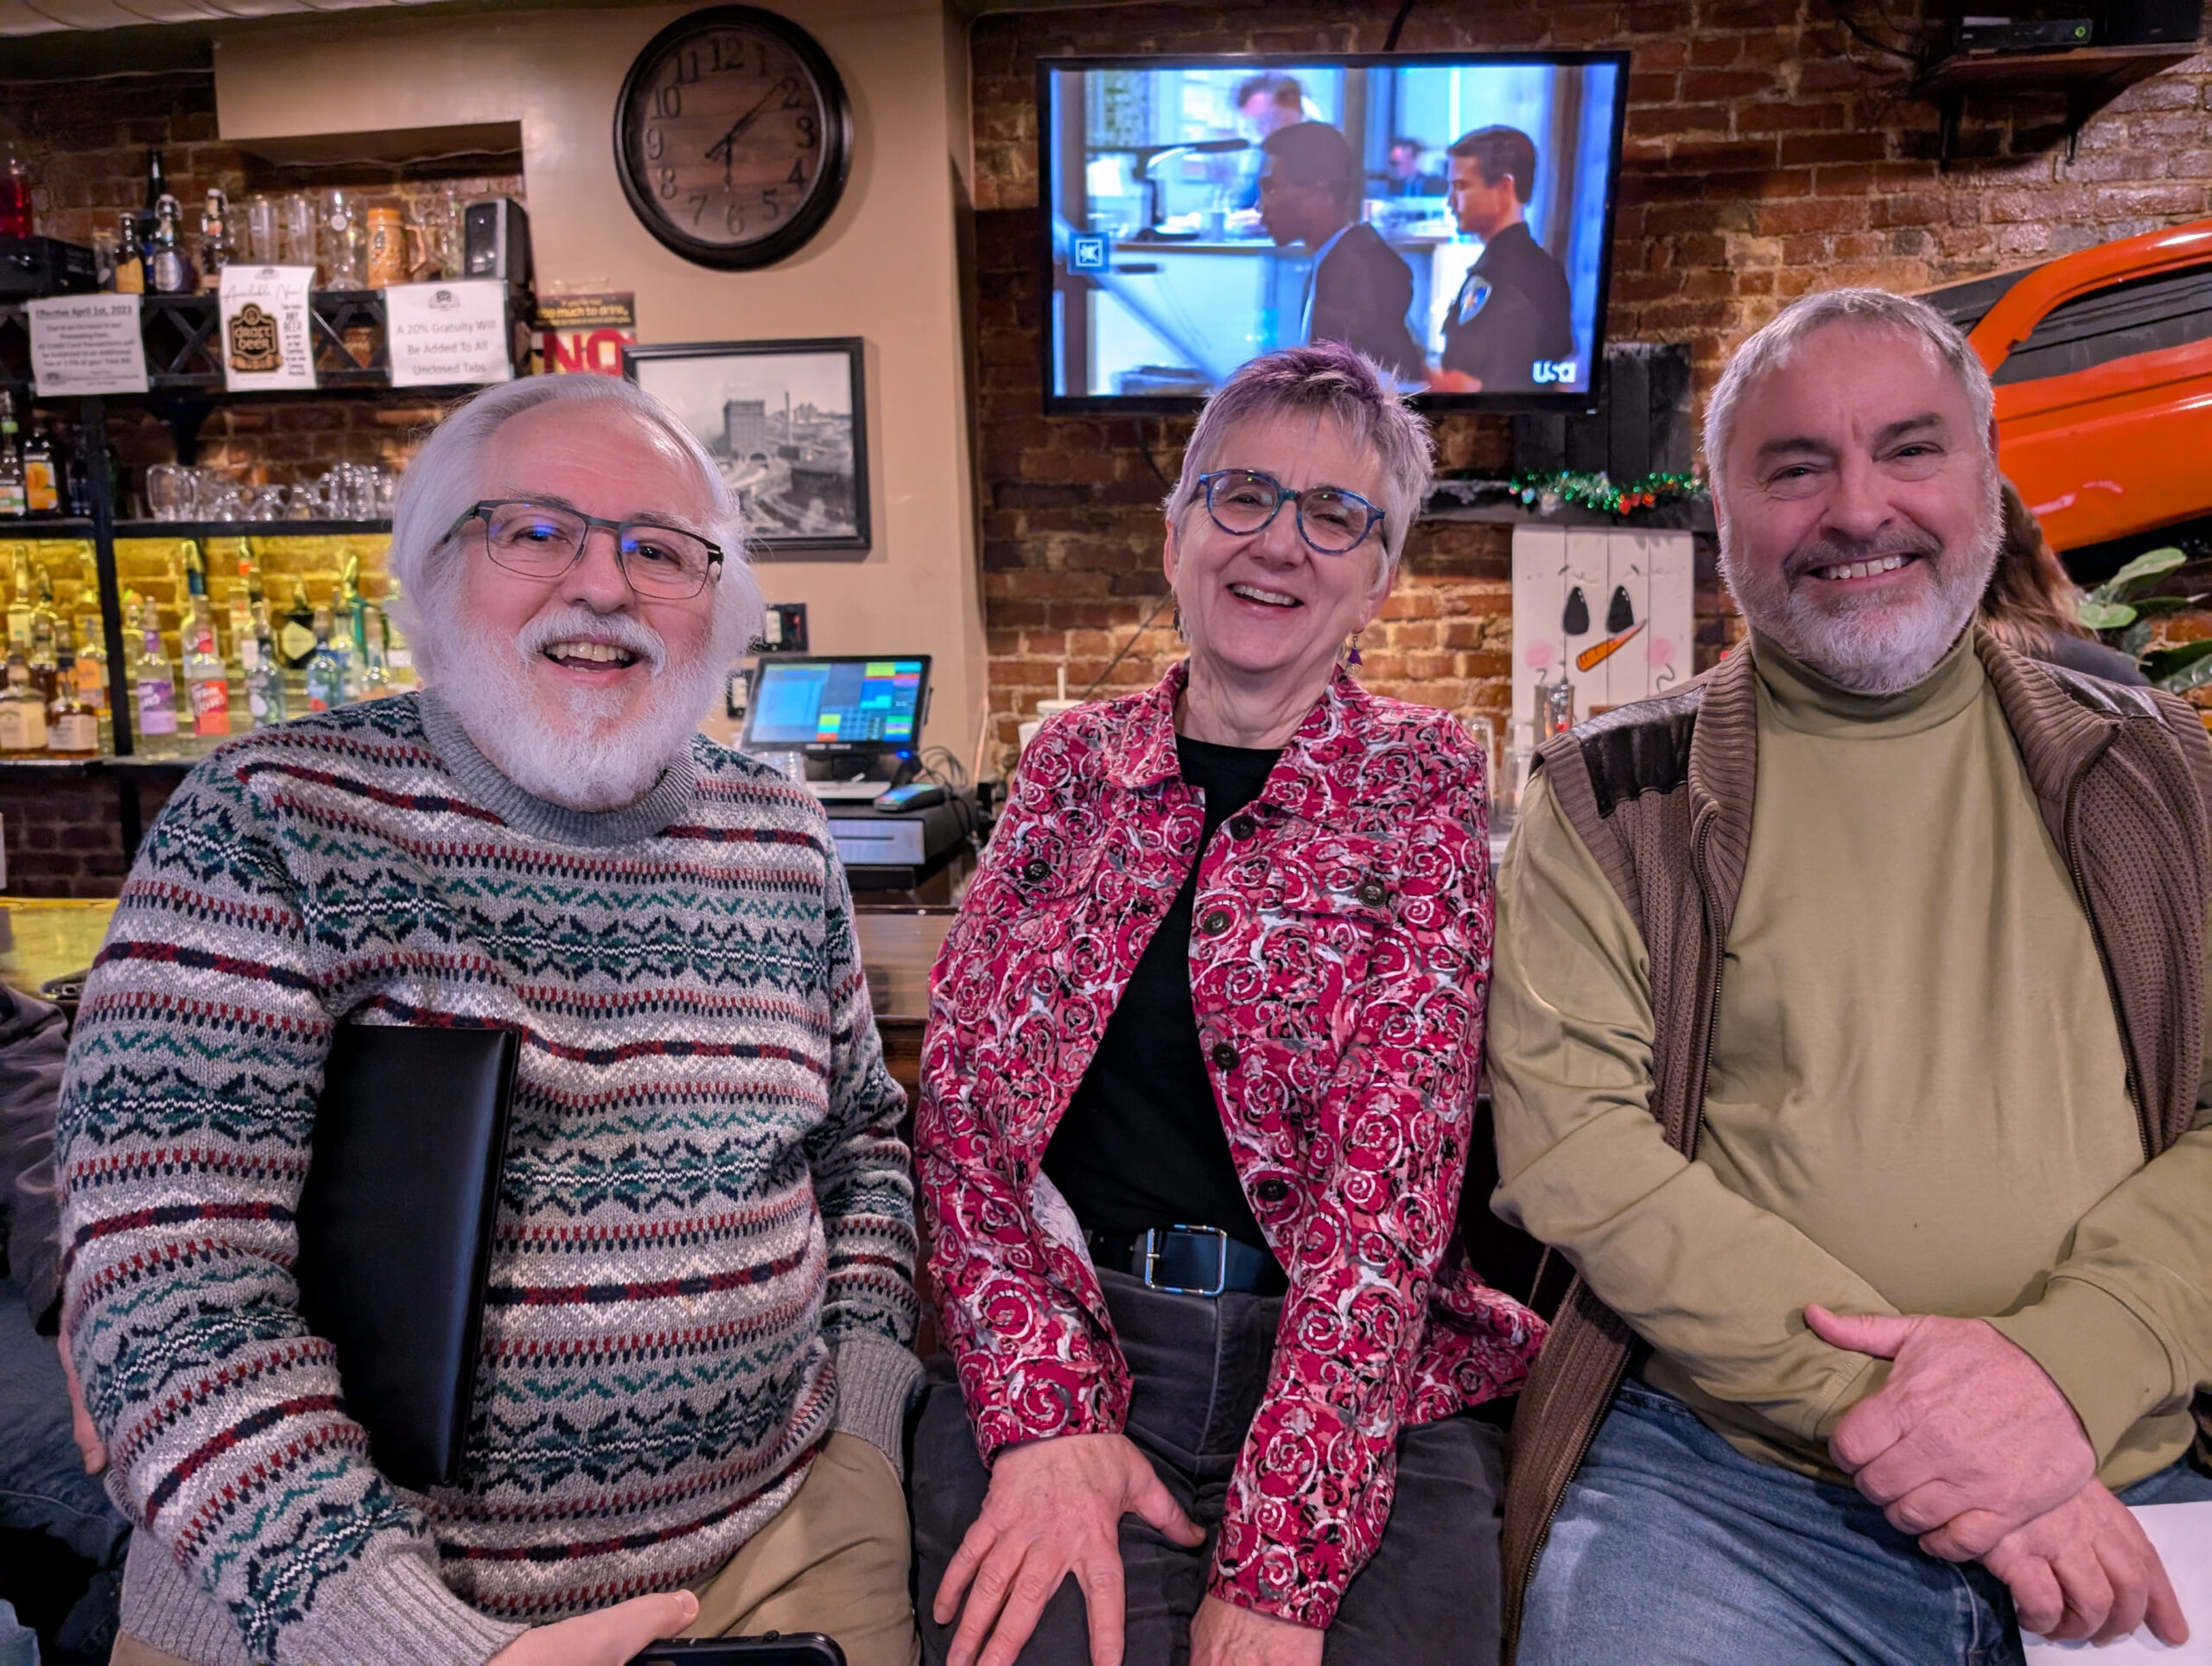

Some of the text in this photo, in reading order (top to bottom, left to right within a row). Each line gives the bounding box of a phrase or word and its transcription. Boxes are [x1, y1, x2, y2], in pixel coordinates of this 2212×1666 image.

[673, 50, 700, 84] 11
[709, 37, 743, 71] 12
[755, 43, 769, 77] 1
[650, 86, 681, 119] 10
[781, 76, 802, 110] 2
[645, 128, 664, 161] 9
[796, 117, 815, 149] 3
[658, 168, 677, 200] 8
[787, 159, 806, 191] 4
[690, 194, 708, 227] 7
[726, 204, 744, 236] 6
[762, 188, 779, 220] 5
[35, 308, 69, 318] Effective
[72, 307, 91, 317] April
[93, 306, 110, 316] 1st,
[397, 318, 497, 335] A 20% Gratuity Will
[556, 308, 585, 318] much
[586, 306, 598, 316] to
[234, 326, 272, 339] draft
[238, 337, 270, 350] beer
[407, 340, 488, 355] Be Added To All
[412, 360, 486, 376] Unclosed Tabs
[543, 328, 624, 378] NO
